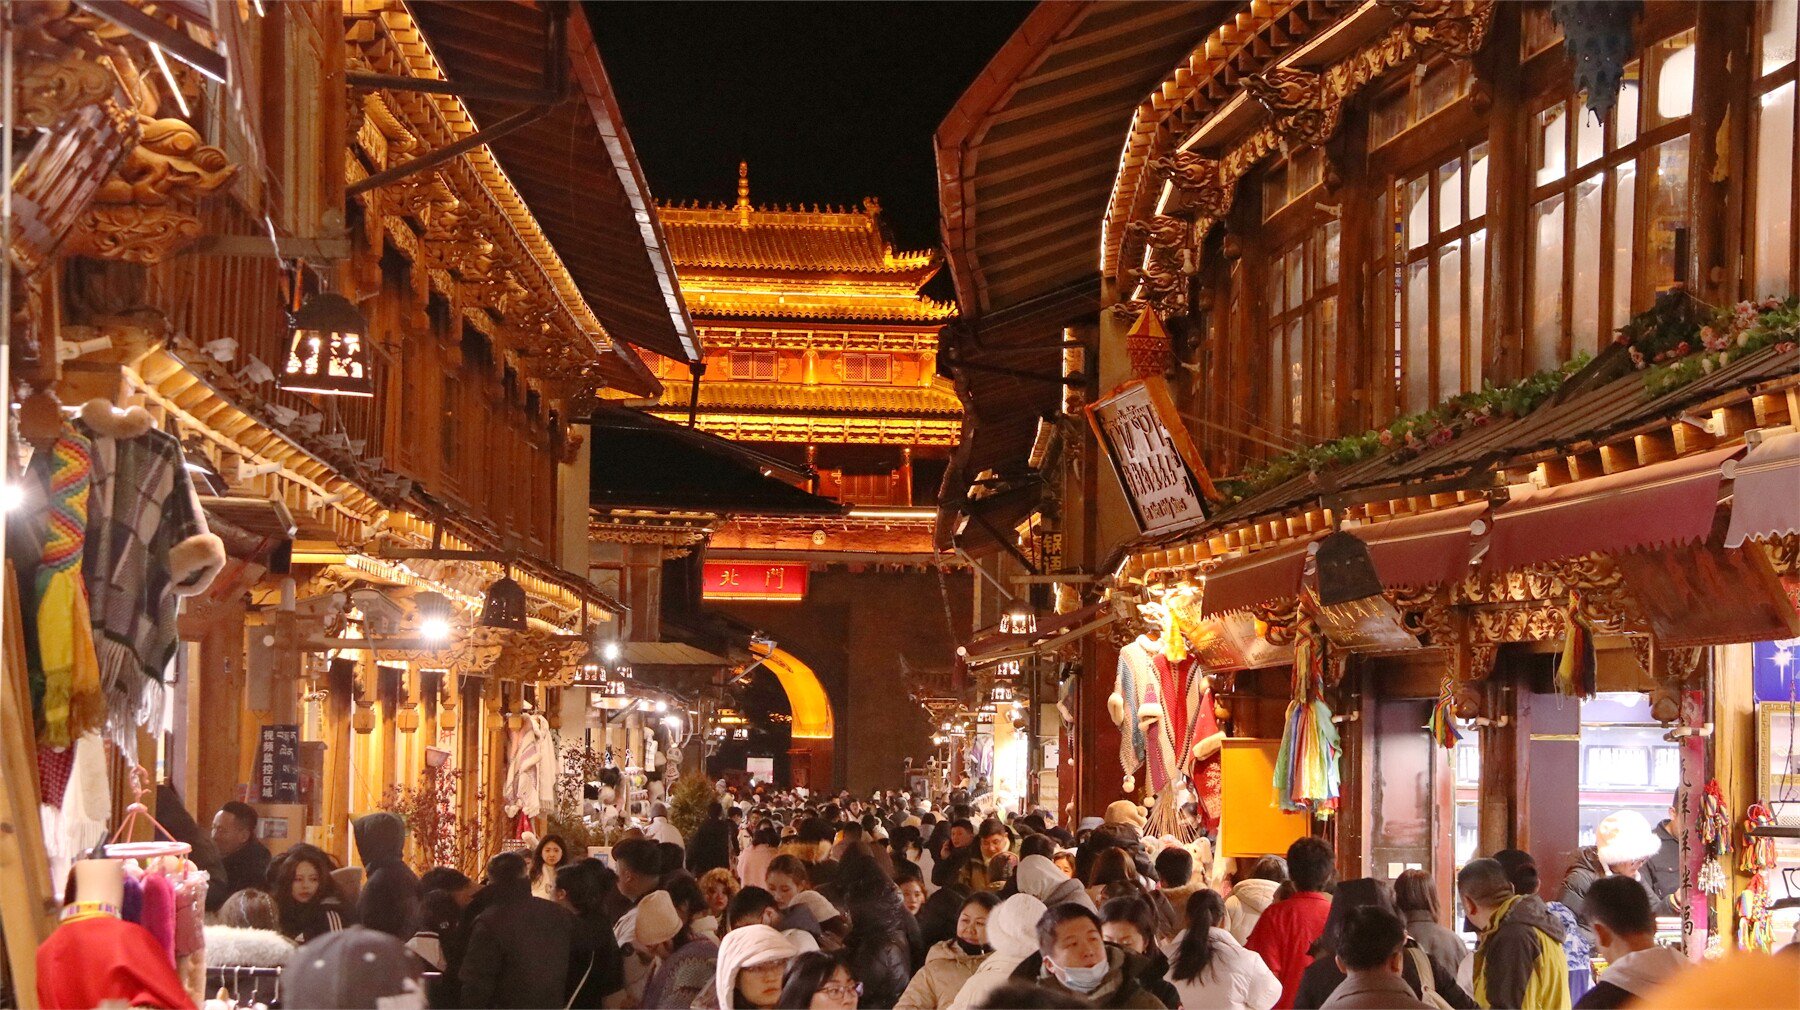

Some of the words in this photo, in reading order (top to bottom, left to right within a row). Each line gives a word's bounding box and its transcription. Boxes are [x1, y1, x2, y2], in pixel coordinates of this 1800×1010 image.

[262, 730, 274, 798] 视频监控区域
